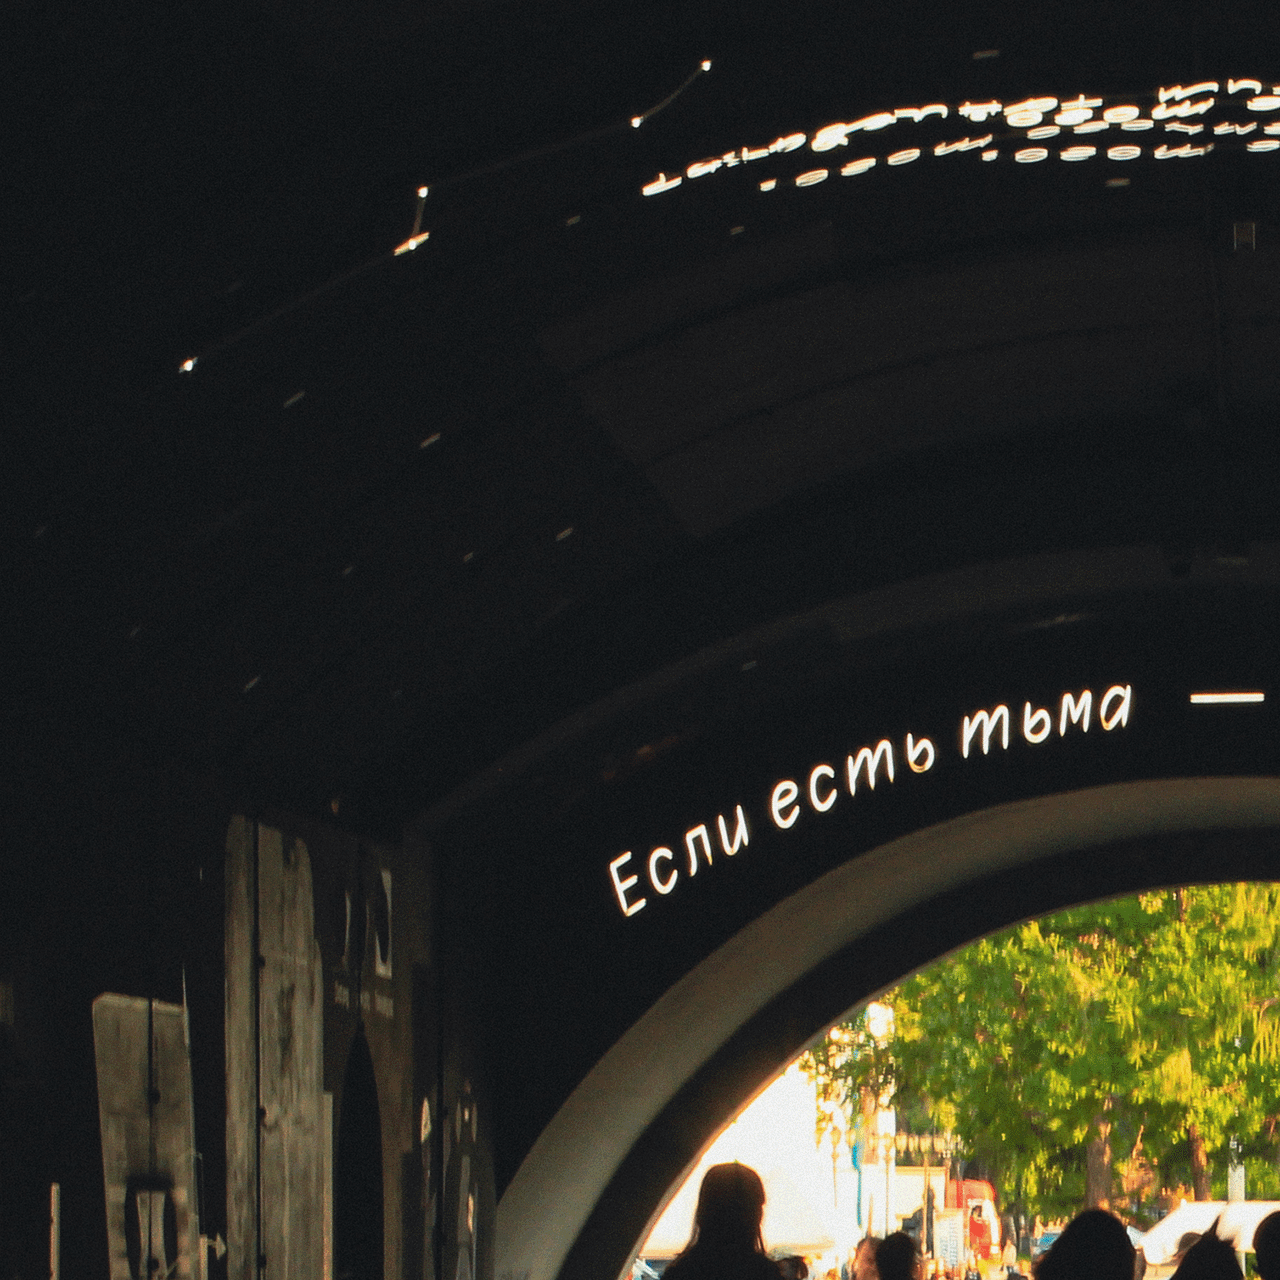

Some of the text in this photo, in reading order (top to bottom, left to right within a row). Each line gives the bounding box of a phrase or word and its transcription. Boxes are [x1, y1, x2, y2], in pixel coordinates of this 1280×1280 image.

[609, 804, 750, 917] Если
[770, 732, 935, 830] есть
[961, 684, 1132, 759] тьма
